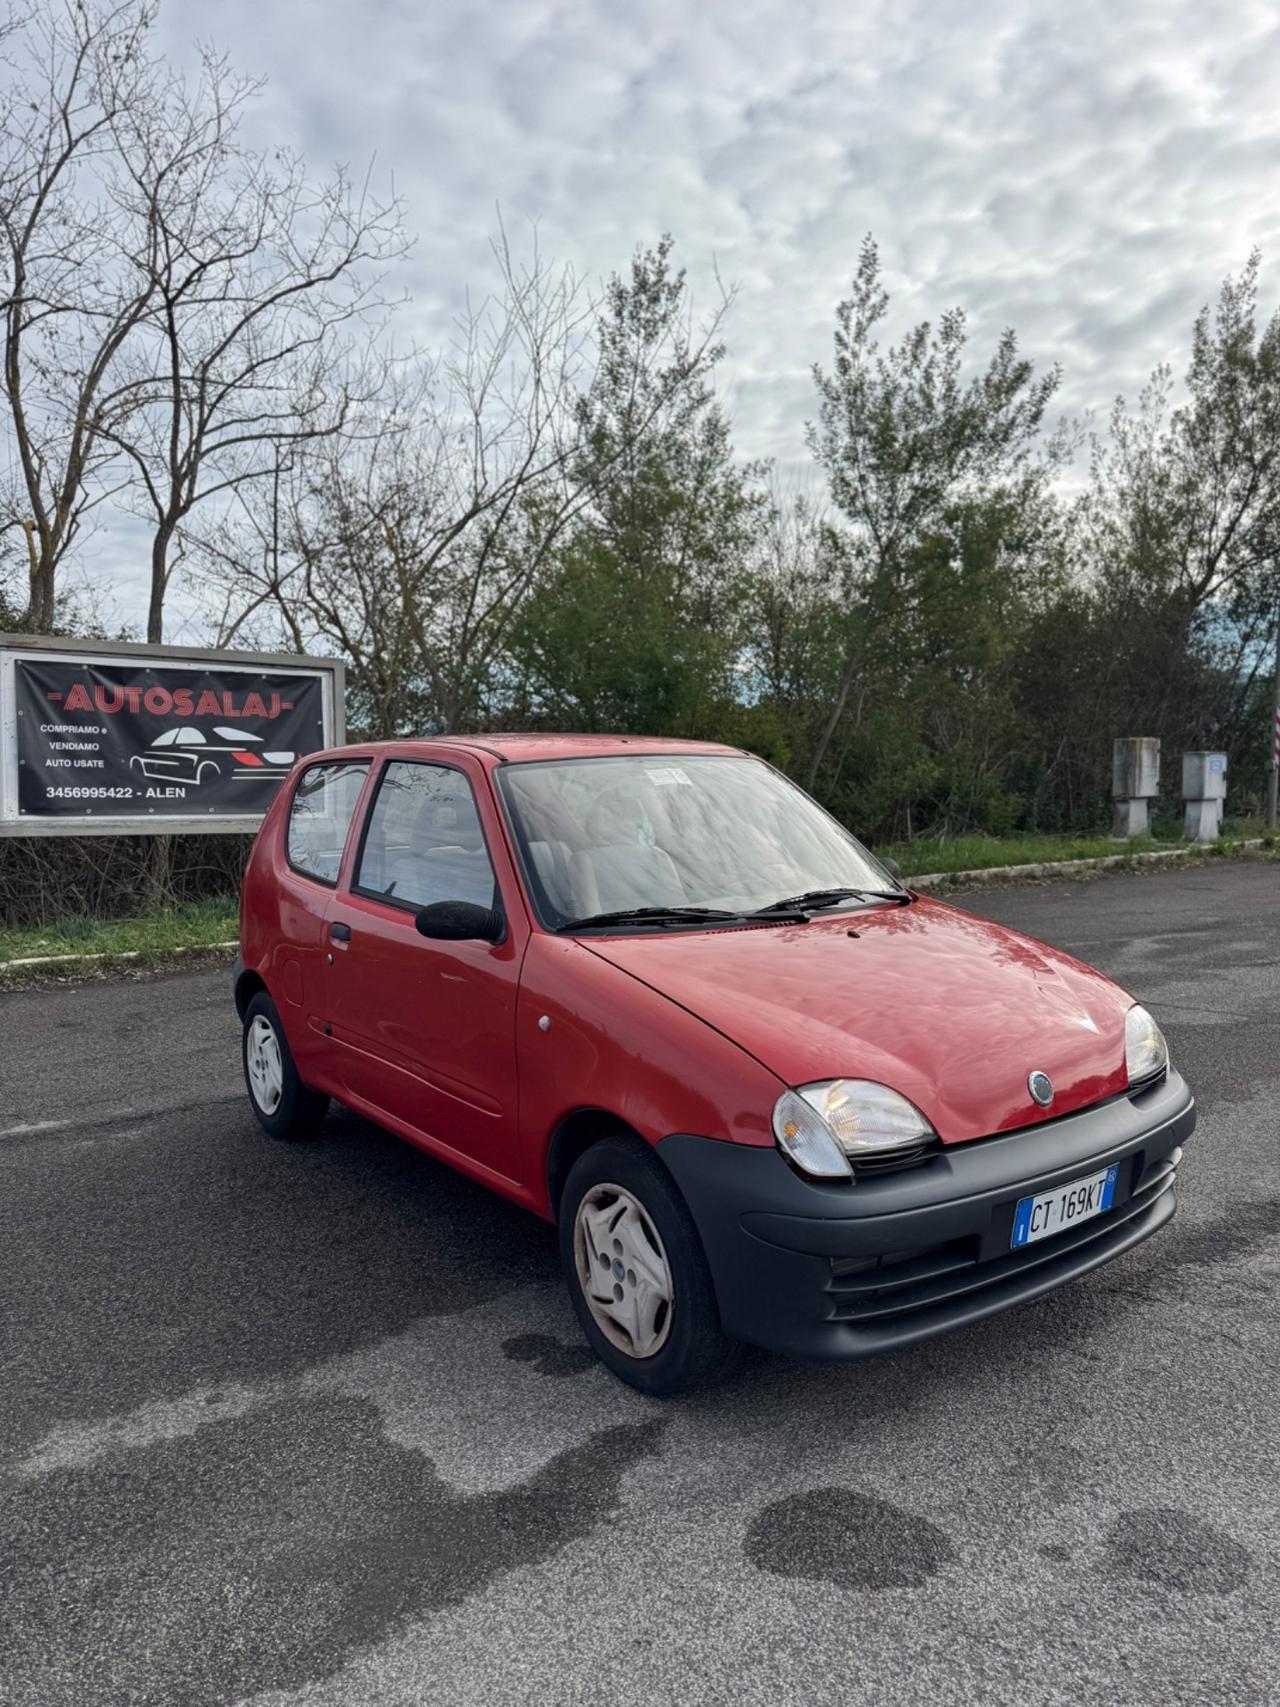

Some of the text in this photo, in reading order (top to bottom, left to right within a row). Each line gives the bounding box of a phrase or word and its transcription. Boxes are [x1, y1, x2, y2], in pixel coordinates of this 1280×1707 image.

[40, 724, 99, 735] COMPRIAMO
[49, 741, 99, 751] VENDIAMO
[45, 758, 104, 768] AUTO USATE
[46, 787, 132, 798] 3456995422
[145, 787, 186, 798] ALEN
[1031, 1200, 1054, 1232] CT
